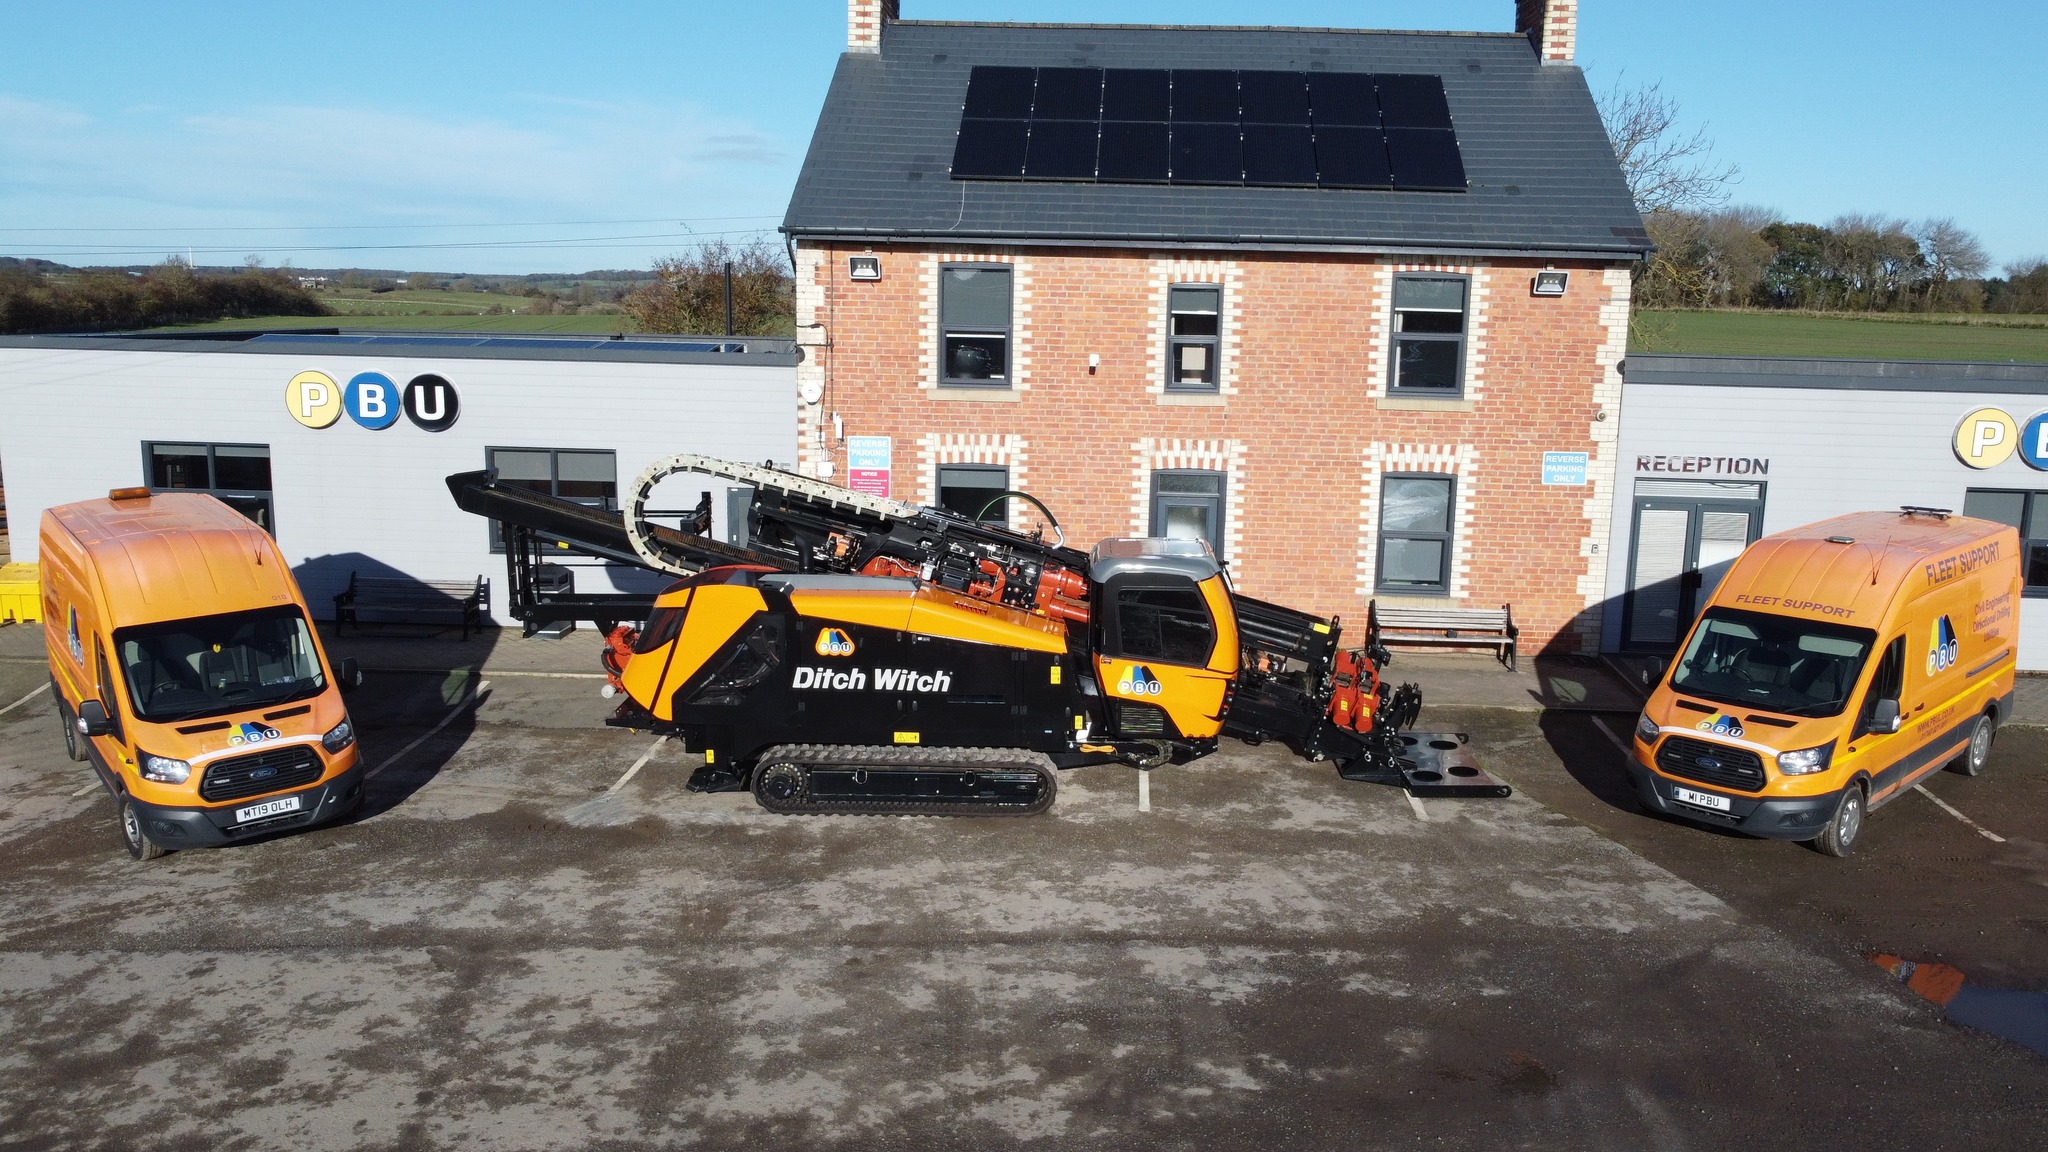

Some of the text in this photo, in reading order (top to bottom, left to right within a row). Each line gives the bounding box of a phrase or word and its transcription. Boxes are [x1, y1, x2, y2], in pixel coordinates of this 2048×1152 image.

[850, 440, 888, 448] REVERSE
[851, 449, 887, 457] PARKING
[858, 458, 880, 466] ONLY
[1546, 455, 1586, 463] REVERSE
[1546, 465, 1584, 473] PARKING
[1636, 454, 1770, 475] RECEPTION
[1553, 474, 1576, 482] ONLY
[1925, 541, 2000, 586] FLEET SUPPORT
[1736, 594, 1856, 619] FLEET SUPPORT
[792, 666, 951, 692] Ditch Witch
[1699, 796, 1720, 807] PBU
[243, 800, 293, 819] MT19 OLH
